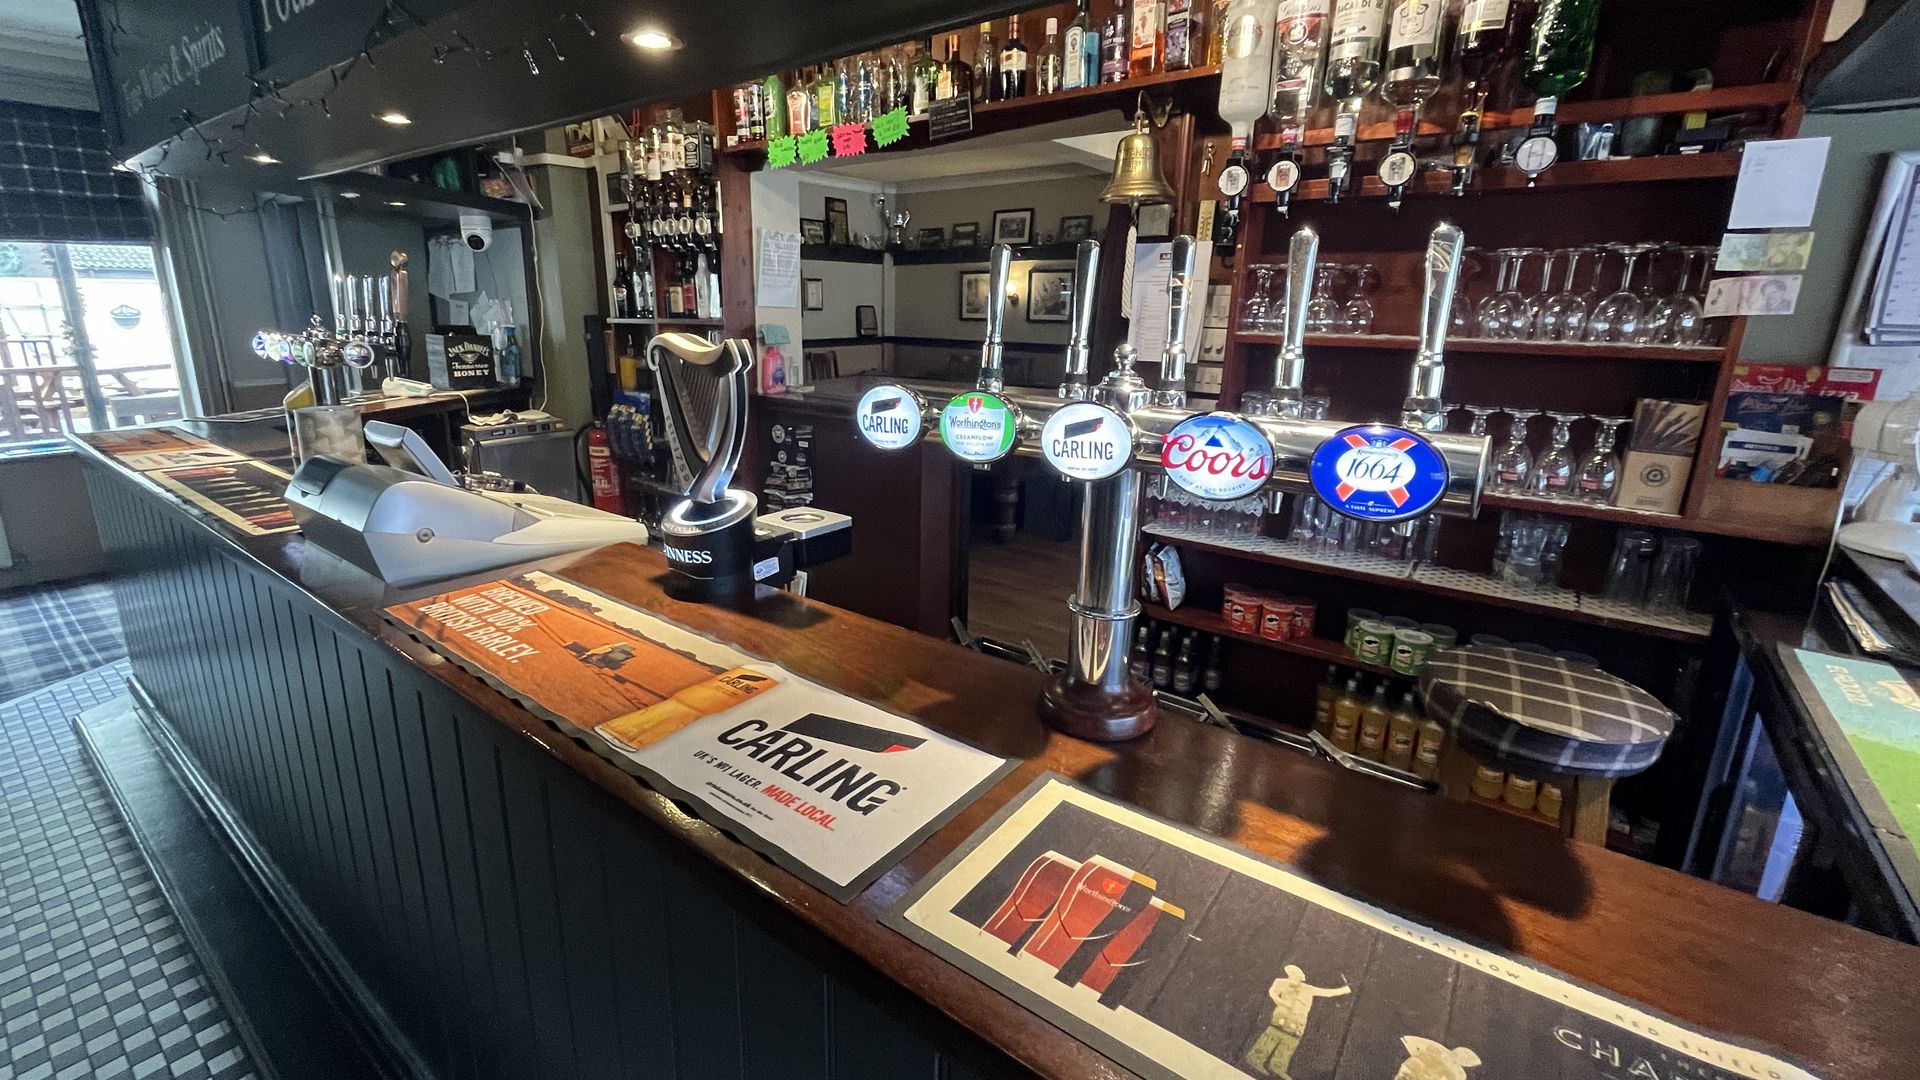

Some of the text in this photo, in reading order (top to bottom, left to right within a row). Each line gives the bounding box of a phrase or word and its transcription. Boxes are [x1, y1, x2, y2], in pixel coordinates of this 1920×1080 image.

[447, 344, 464, 358] JACK
[453, 369, 490, 377] HONEY
[862, 414, 909, 434] CARLING
[949, 415, 1002, 430] Worthington's
[1052, 439, 1114, 461] CARLING
[1161, 433, 1269, 481] Coors
[1346, 456, 1404, 484] 1664
[451, 593, 538, 633] WITH 100%
[480, 586, 550, 616] BREWED
[417, 601, 541, 664] BRITISH BARLEY.
[719, 676, 759, 694] CARLING
[717, 719, 901, 816] CARLING
[693, 750, 717, 764] UK'S
[728, 769, 762, 790] LAGER.
[760, 784, 801, 808] MADE
[794, 801, 837, 832] LOCAL.
[1392, 925, 1520, 979] CREAMFLOW
[1615, 1013, 1660, 1036] RED
[1680, 1040, 1782, 1079] SHIELD
